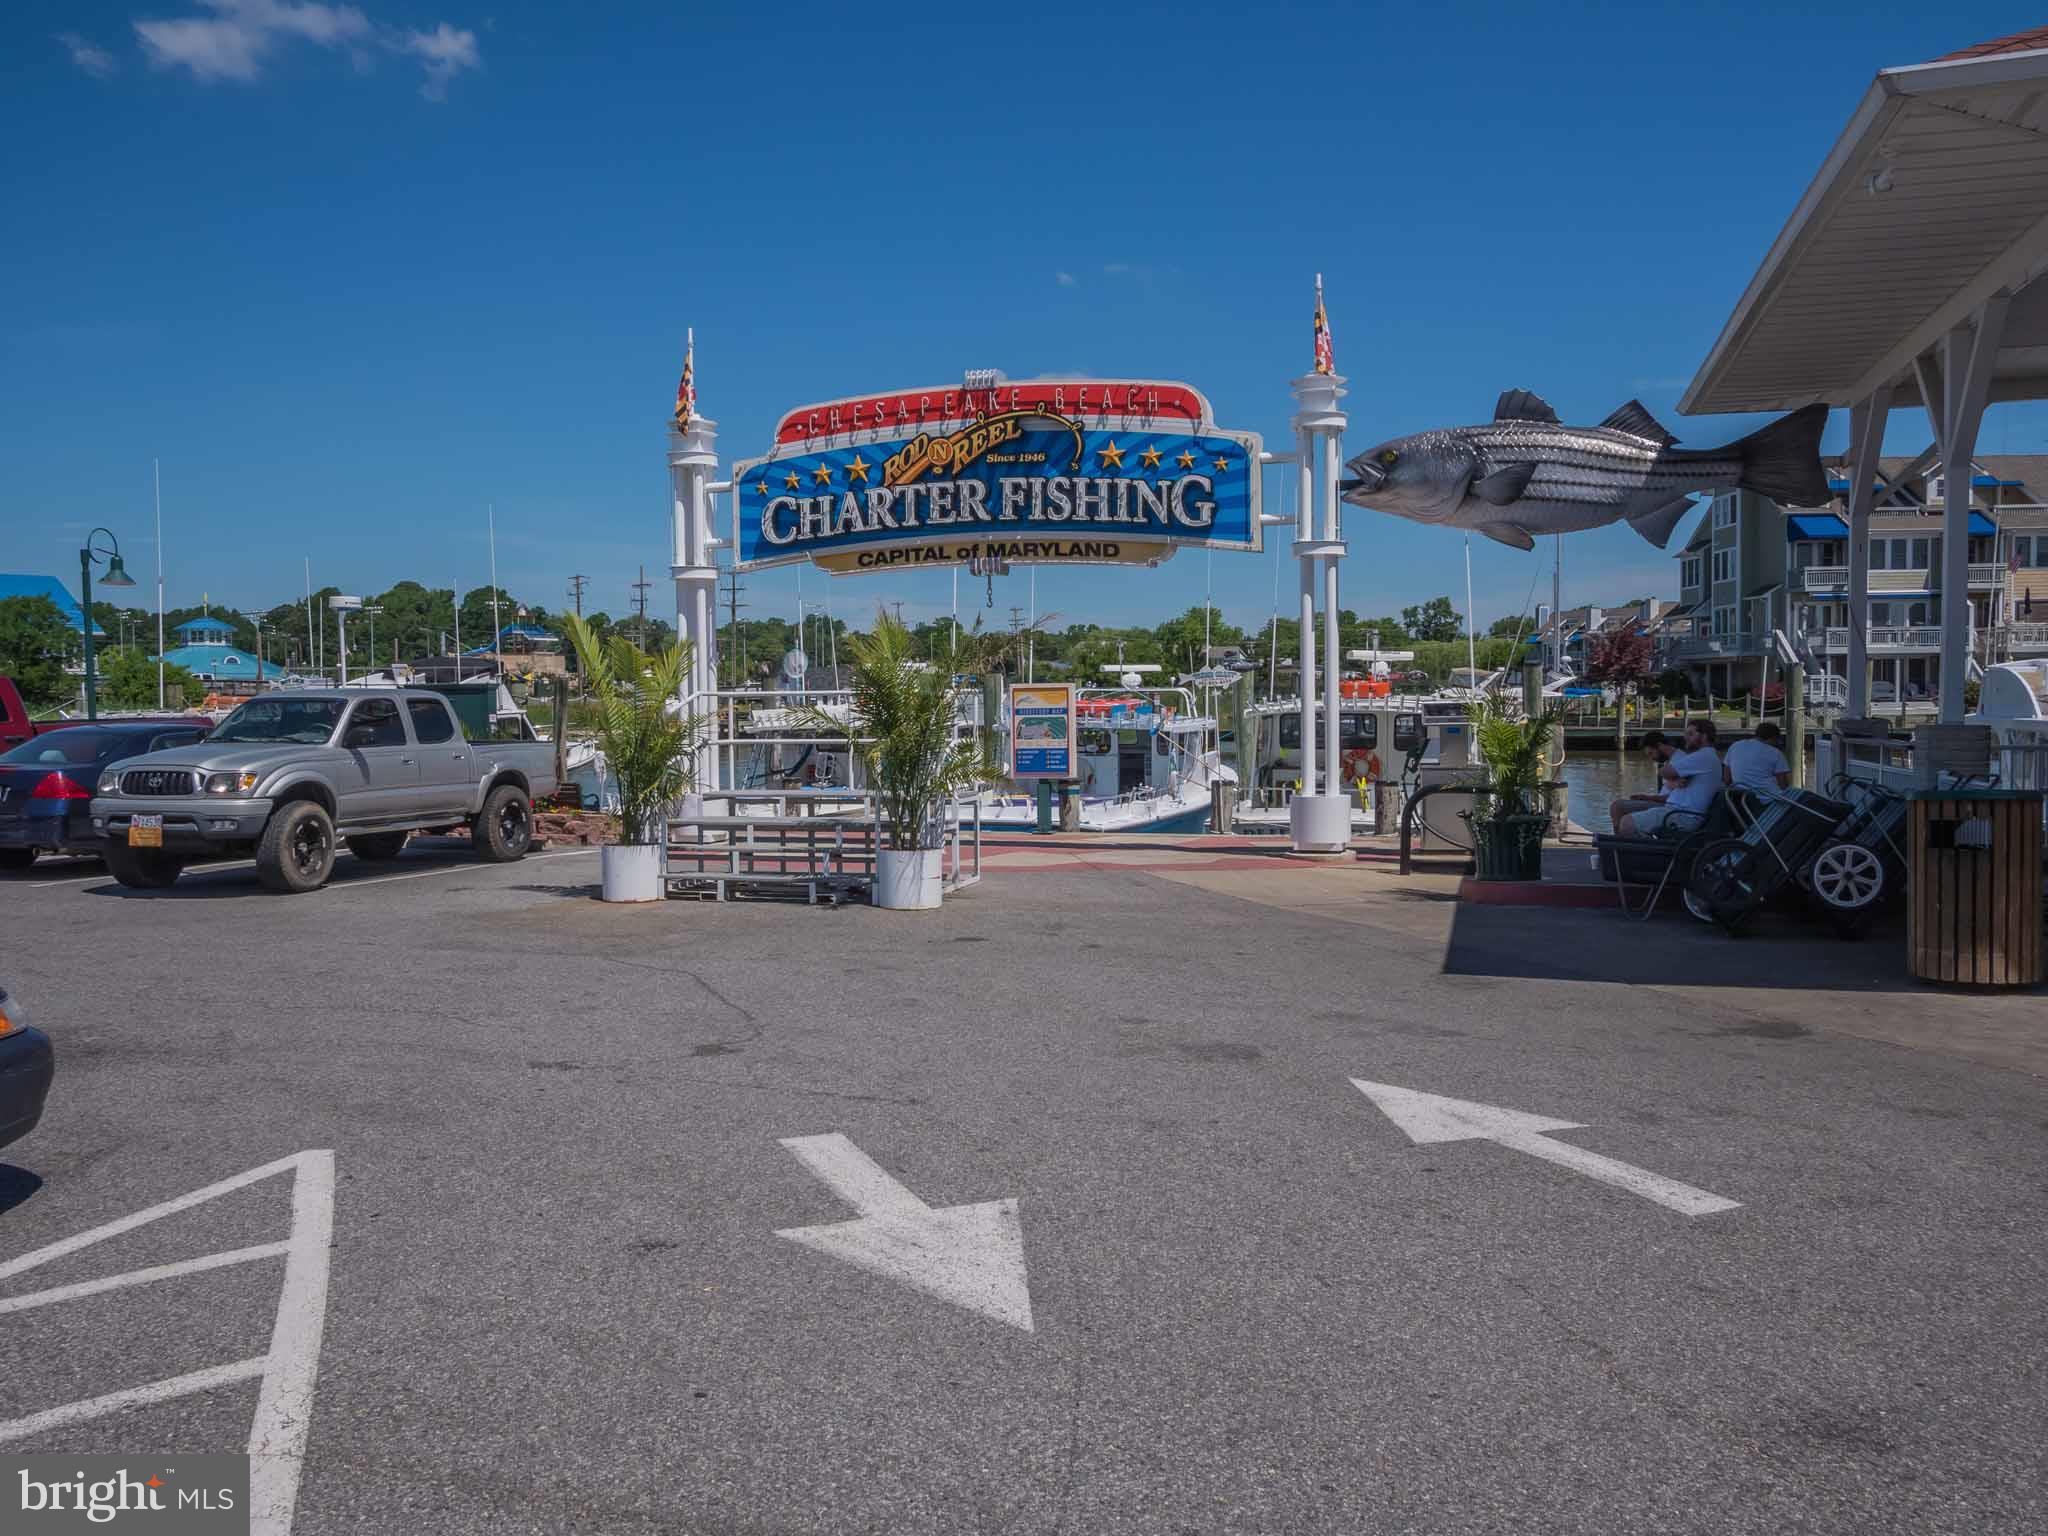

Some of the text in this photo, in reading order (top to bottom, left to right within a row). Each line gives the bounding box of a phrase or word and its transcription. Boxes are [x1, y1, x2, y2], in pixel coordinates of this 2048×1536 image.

[808, 384, 1160, 434] CHESAPEAKE BEACH
[884, 433, 929, 487] ROD
[952, 419, 1022, 475] REEL
[987, 453, 1046, 463] Since 1946
[762, 474, 1213, 545] CHARTER FISHING
[857, 541, 1120, 568] CAPITAL of MARYLAND
